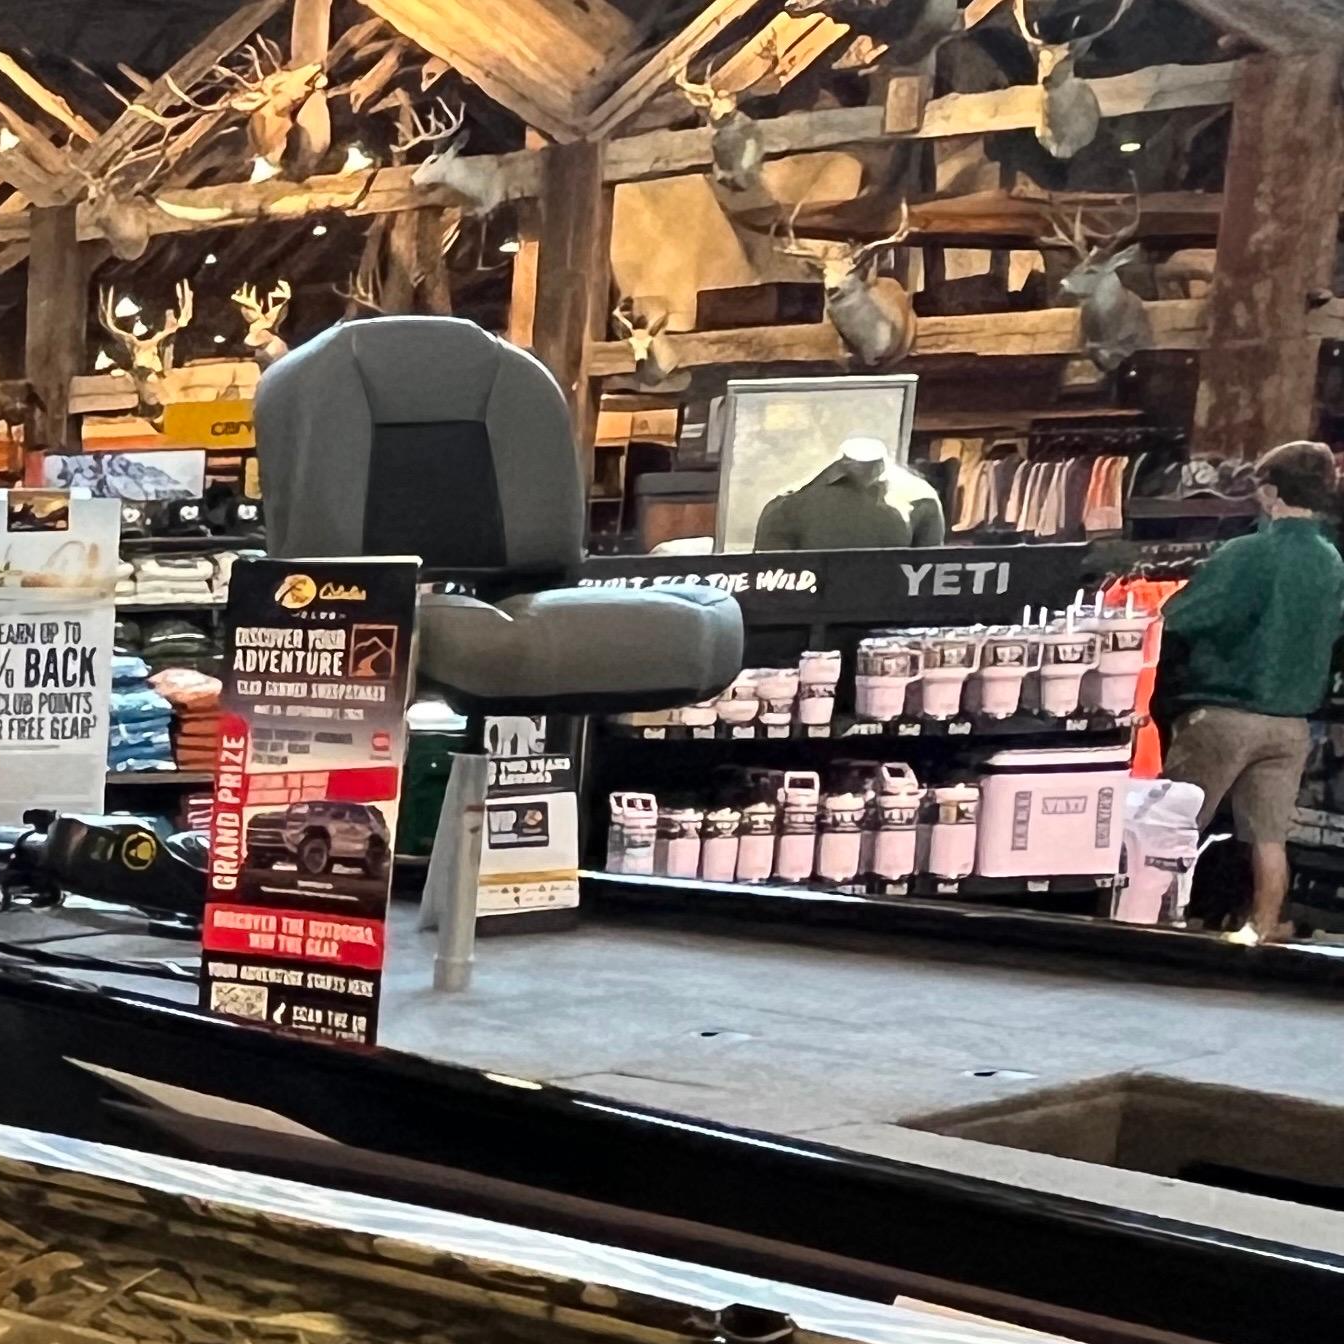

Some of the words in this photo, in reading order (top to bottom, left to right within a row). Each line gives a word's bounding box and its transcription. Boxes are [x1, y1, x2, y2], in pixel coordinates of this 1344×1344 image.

[900, 562, 1010, 596] YETI
[40, 622, 59, 644] UP
[64, 621, 81, 644] TO
[24, 646, 97, 688] BACK
[233, 649, 345, 676] ADVENTURE
[38, 692, 93, 714] POINTS
[8, 717, 45, 740] FREE
[217, 735, 245, 804] PRIZE
[212, 812, 241, 890] GRAND
